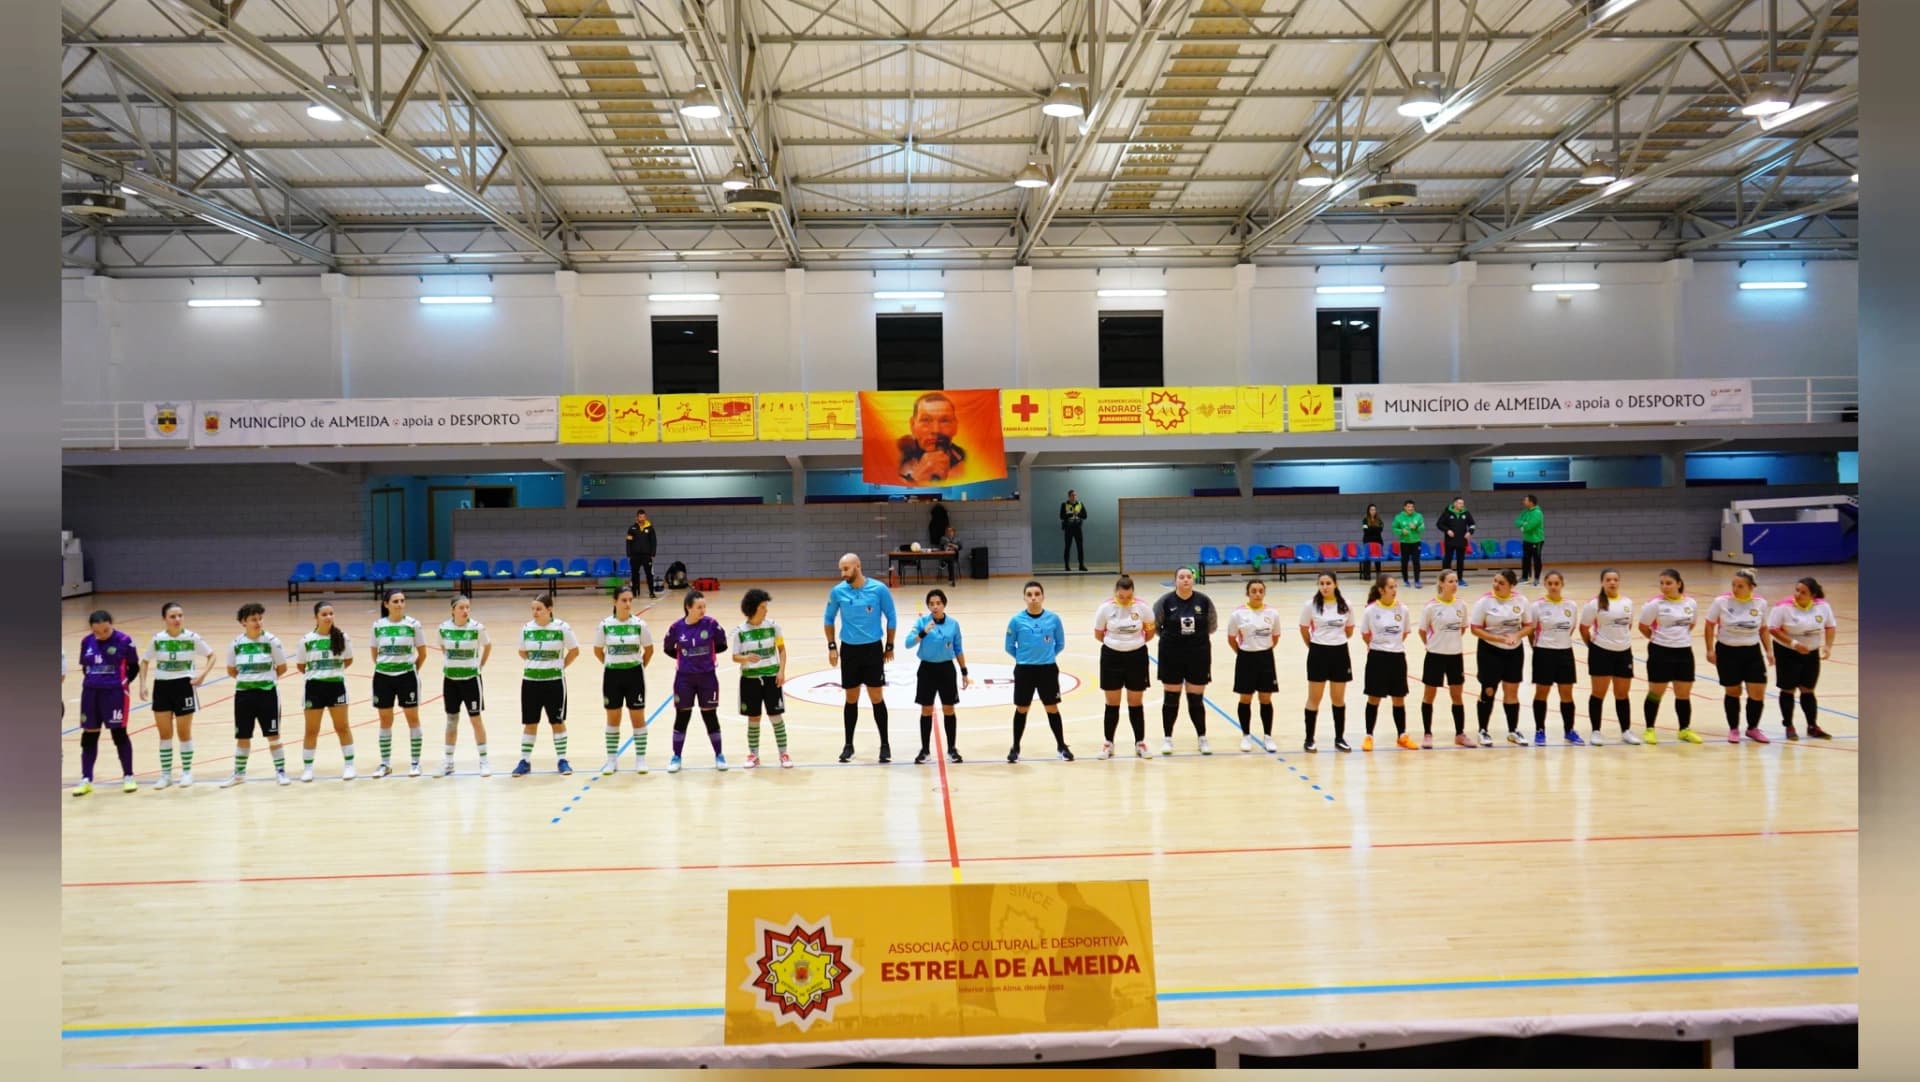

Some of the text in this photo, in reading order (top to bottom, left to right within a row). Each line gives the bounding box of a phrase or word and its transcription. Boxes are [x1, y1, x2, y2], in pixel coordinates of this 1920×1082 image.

[1098, 405, 1142, 413] ANDRADE
[1385, 396, 1469, 413] MUNICÍPIO
[1474, 399, 1491, 412] de
[1495, 397, 1562, 411] ALMEIDA
[1575, 396, 1610, 412] apoia
[1615, 398, 1624, 408] o
[1628, 394, 1705, 409] DESPORTO
[229, 412, 520, 429] MUNICÍPIO de ALMEIDA apoia o DESPORTO
[113, 709, 123, 720] 16
[1009, 884, 1054, 910] SINCE
[888, 936, 1129, 955] ASSOCIAÇÃO CULTURAL E DESPORTIVA
[881, 954, 1141, 982] ESTRELA DE ALMEIDA
